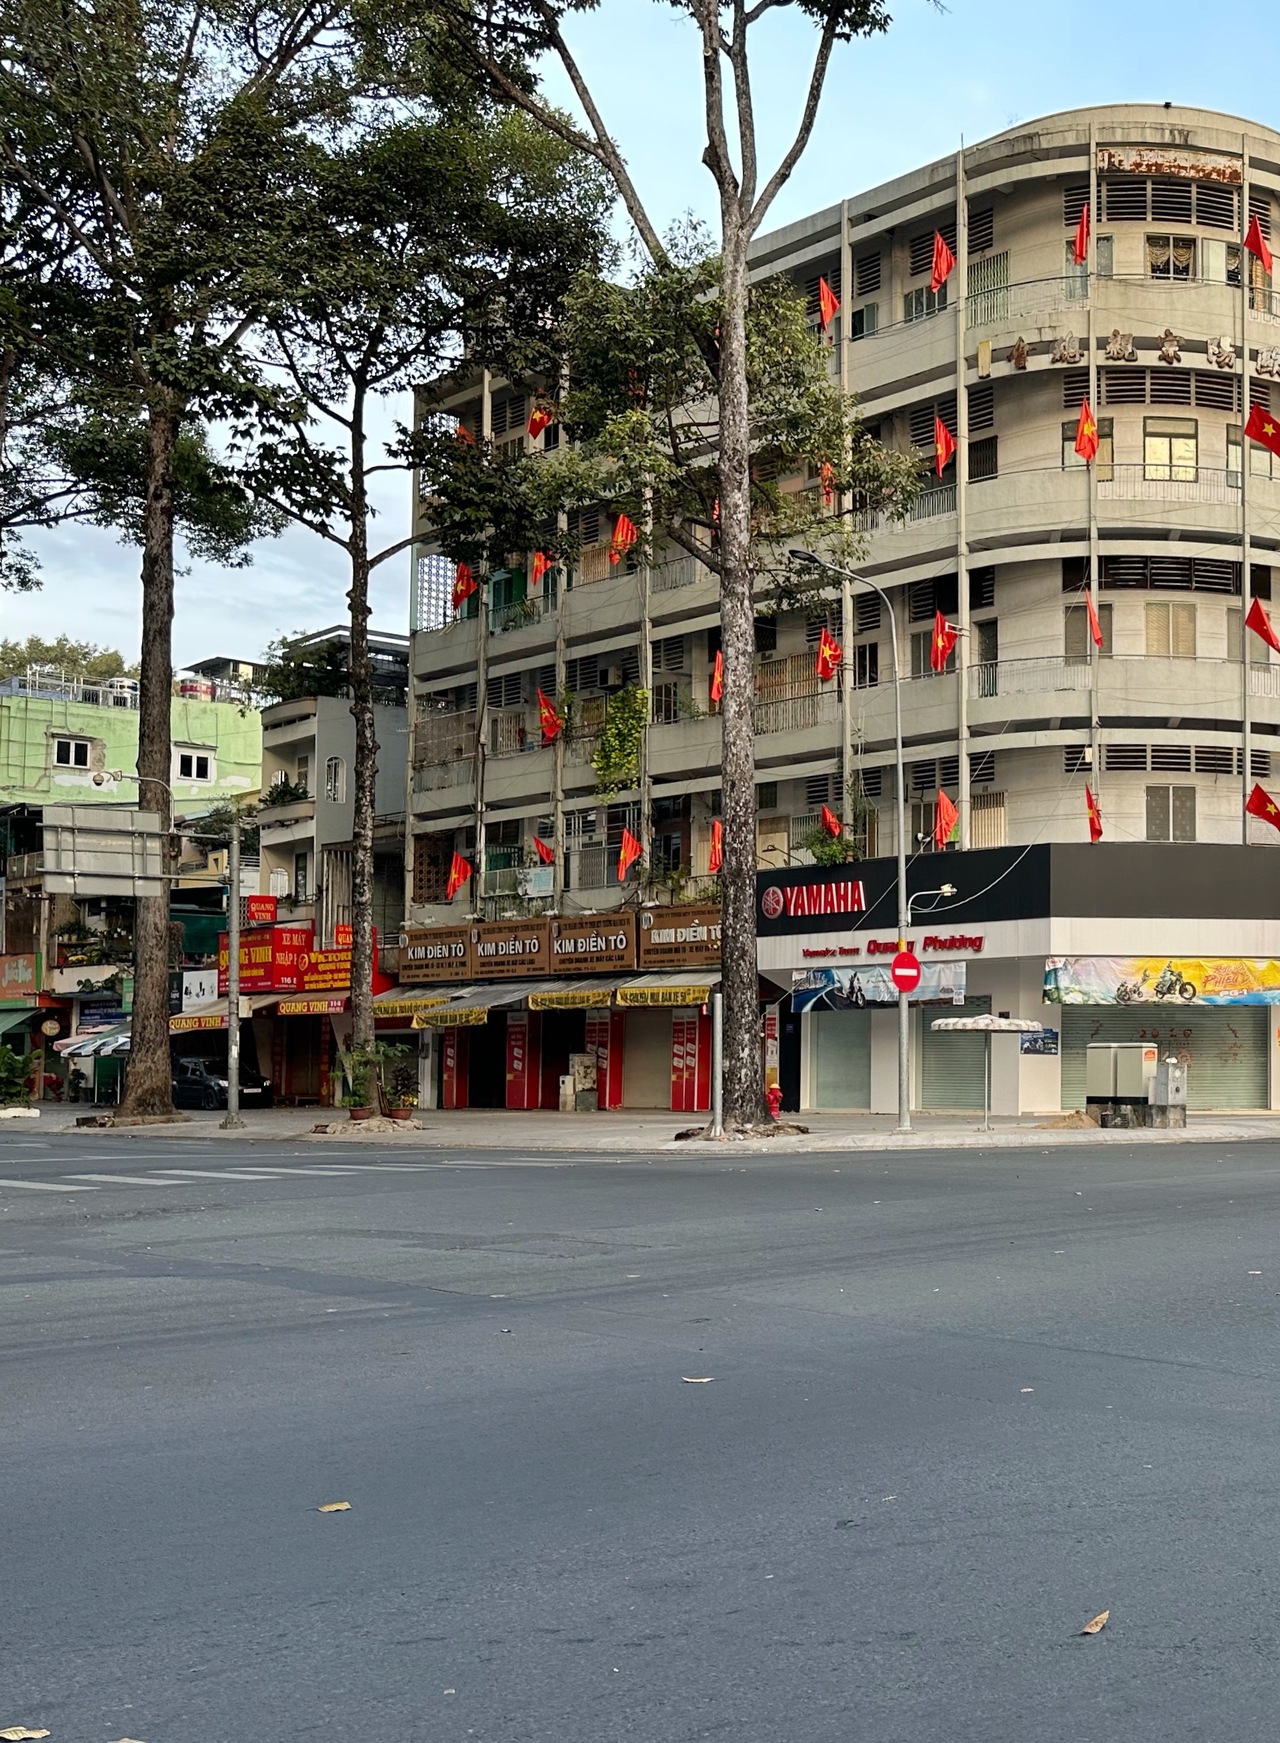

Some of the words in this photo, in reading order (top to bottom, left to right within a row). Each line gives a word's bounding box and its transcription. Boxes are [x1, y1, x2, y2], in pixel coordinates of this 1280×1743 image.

[783, 880, 866, 917] YAMAHA
[251, 903, 274, 911] QUANG
[254, 912, 271, 920] VINH
[282, 933, 291, 945] XE
[292, 931, 306, 946] MÁY
[338, 933, 352, 945] QUAN
[554, 939, 575, 954] KIM
[577, 930, 606, 952] ĐIỀN
[608, 930, 627, 950] TÔ
[651, 928, 675, 943] KIM
[407, 946, 425, 960] KIM
[450, 939, 464, 957] TÔ
[477, 942, 496, 956] KIM
[524, 935, 539, 953] TÔ
[802, 947, 837, 958] Yamaha
[250, 946, 272, 963] VINH
[276, 951, 293, 966] NHẬP
[309, 951, 352, 963] VICTORI
[280, 1001, 308, 1014] QUANG
[309, 1001, 328, 1012] VINH
[169, 1017, 198, 1029] QUANG
[200, 1016, 222, 1028] VINH
